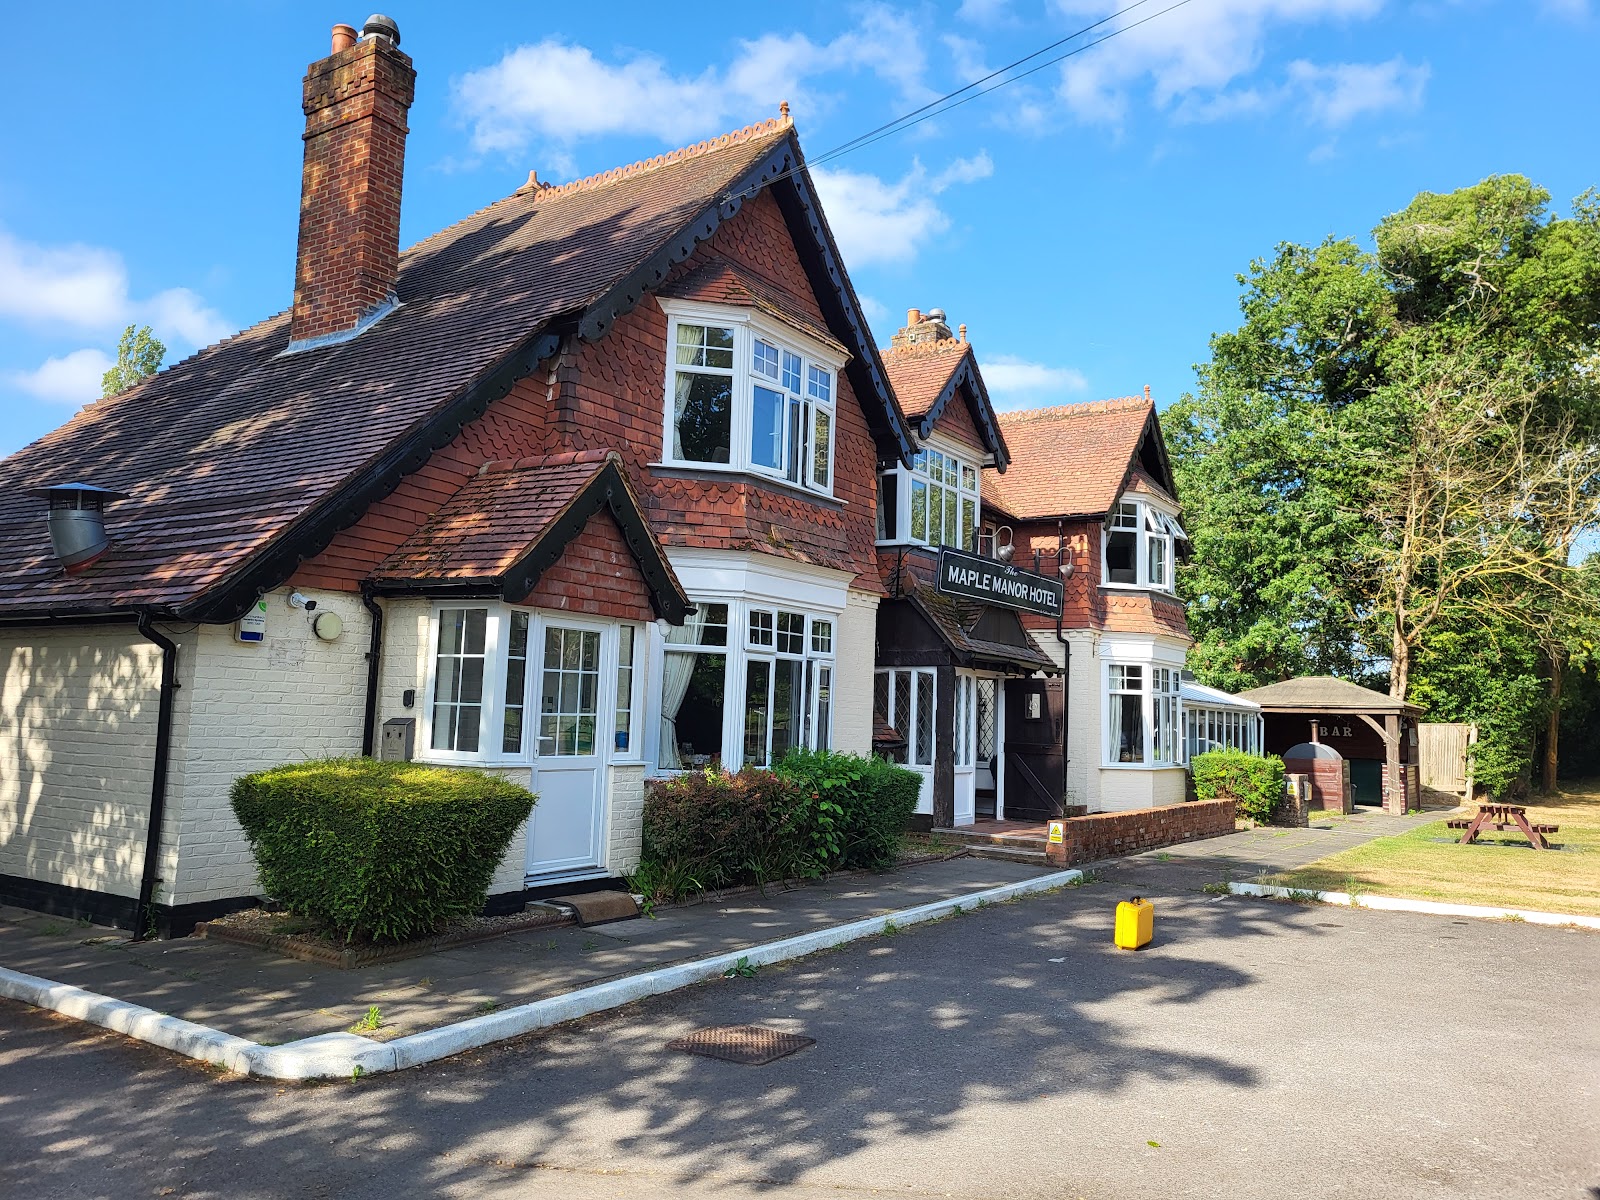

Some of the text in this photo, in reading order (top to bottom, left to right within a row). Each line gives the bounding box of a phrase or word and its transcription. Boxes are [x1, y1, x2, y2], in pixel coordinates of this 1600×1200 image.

[1004, 565, 1019, 577] The
[948, 565, 1058, 608] MAPLE MANOR HOTEL
[1319, 726, 1353, 737] BAR
